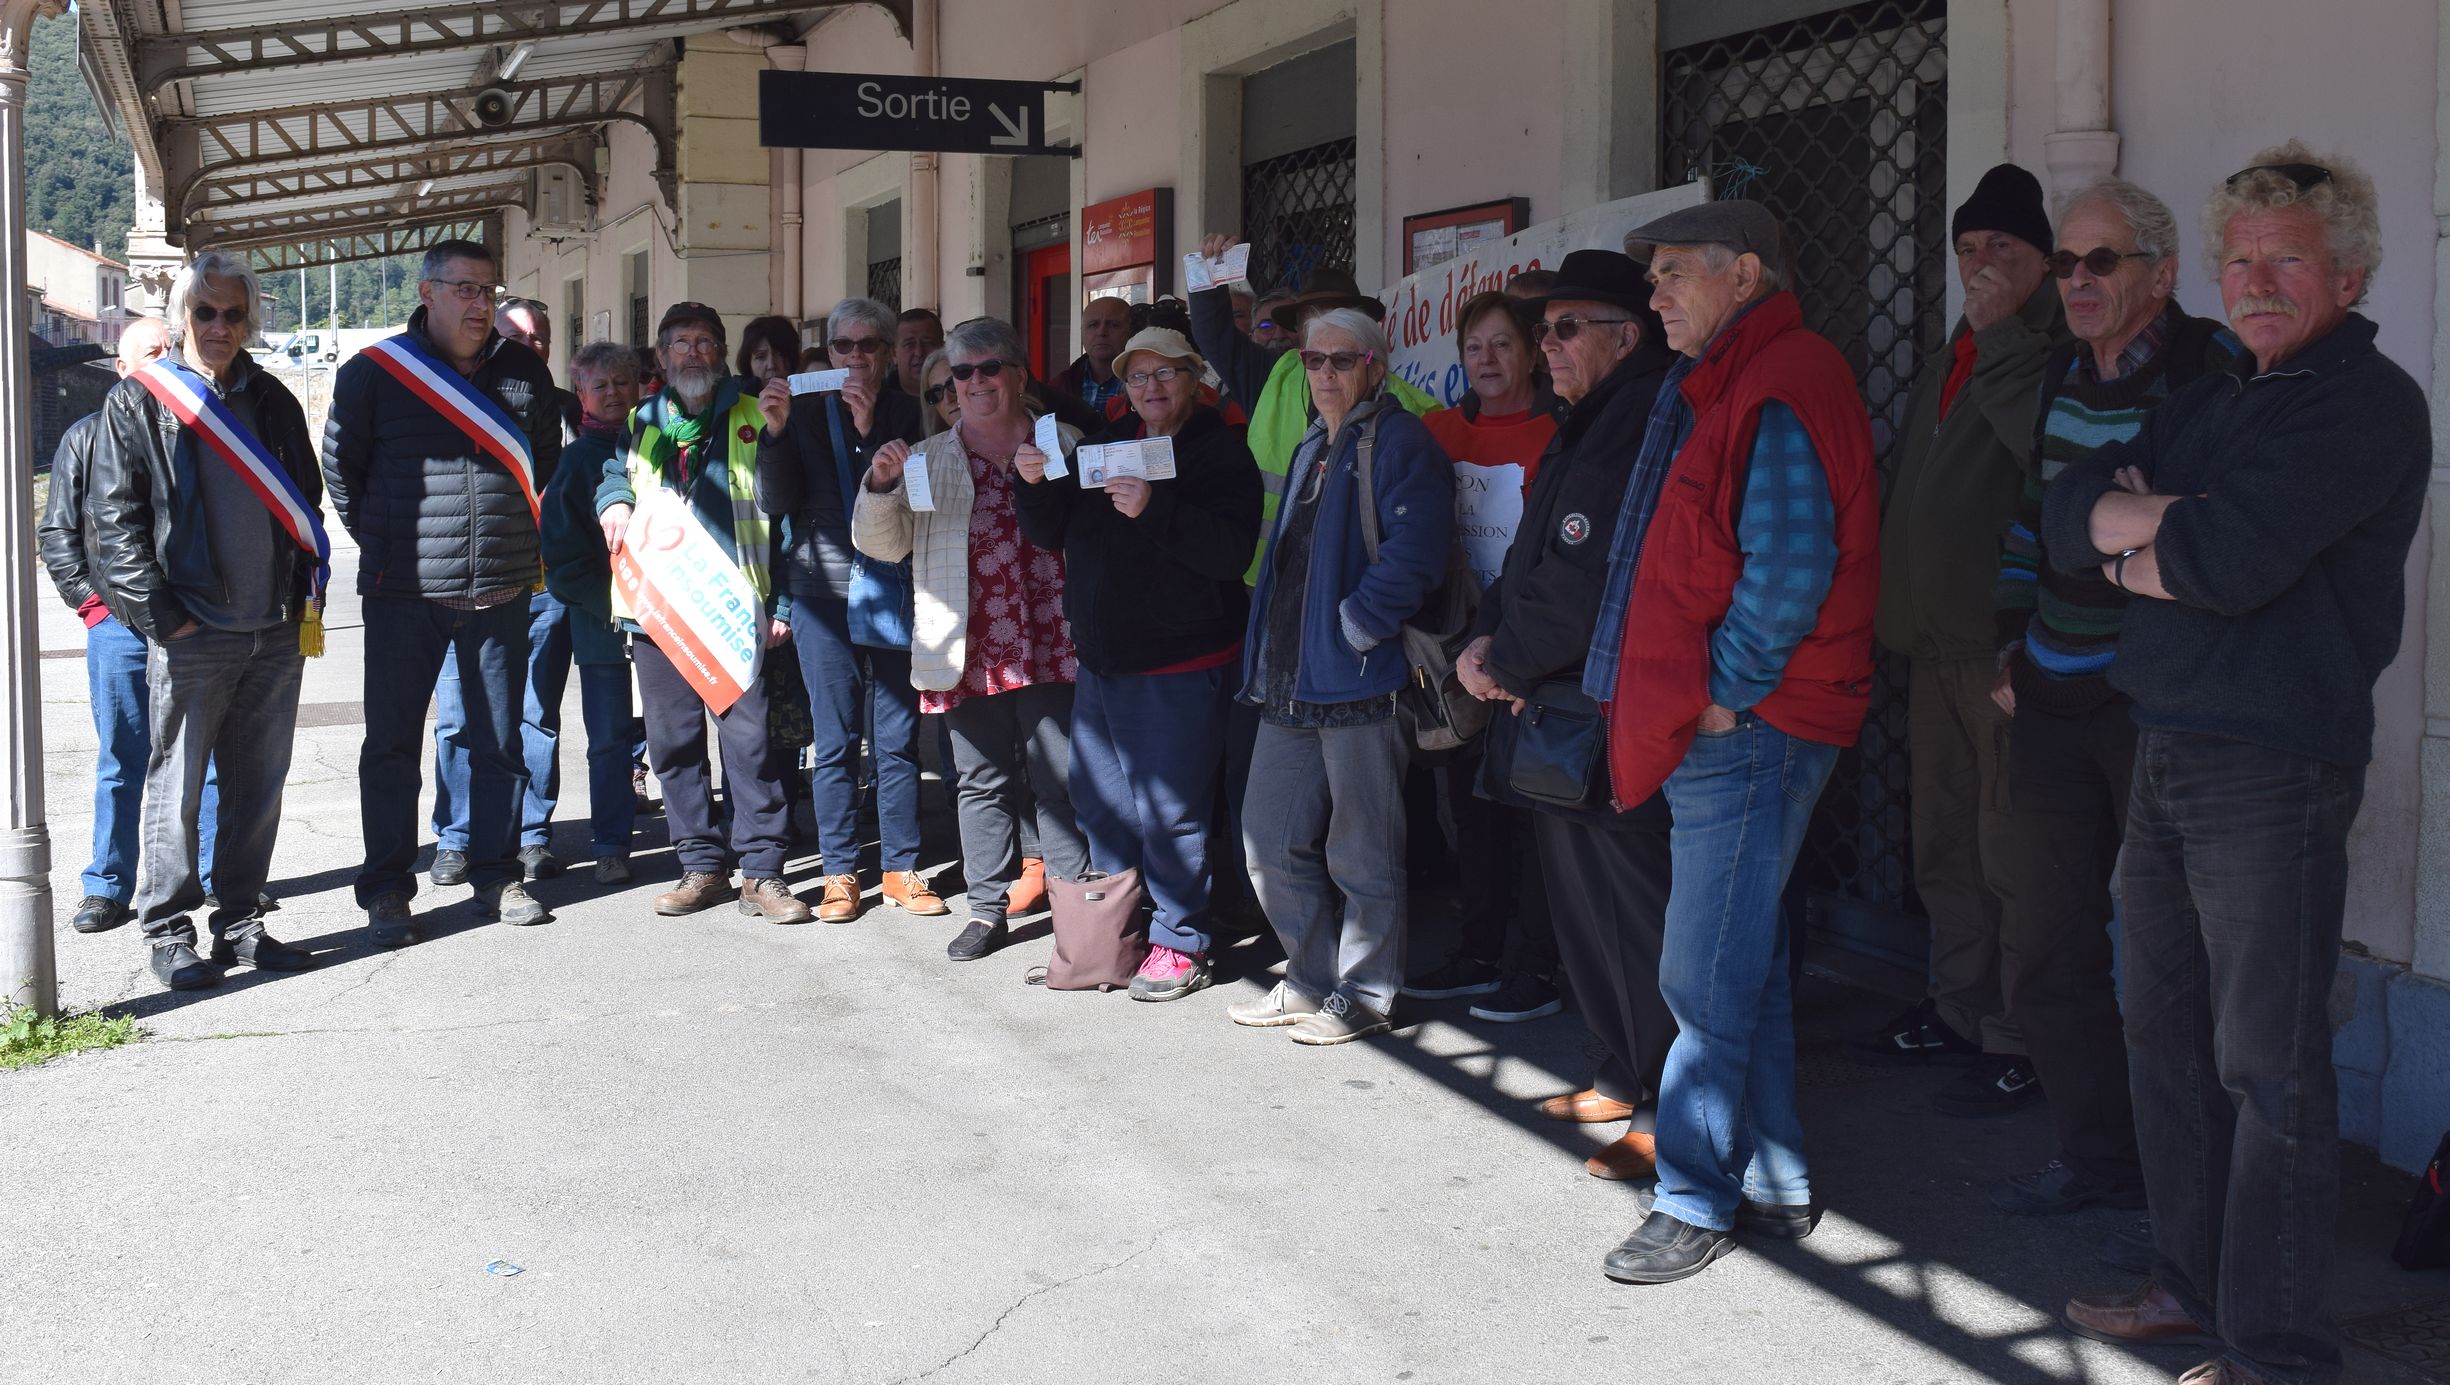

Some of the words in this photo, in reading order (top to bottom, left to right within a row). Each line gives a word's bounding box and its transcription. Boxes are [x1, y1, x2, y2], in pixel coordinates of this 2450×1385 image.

[857, 82, 971, 121] Sortie
[1404, 283, 1431, 348] de
[1439, 258, 1541, 337] défn
[683, 543, 708, 573] La
[707, 571, 762, 648] France
